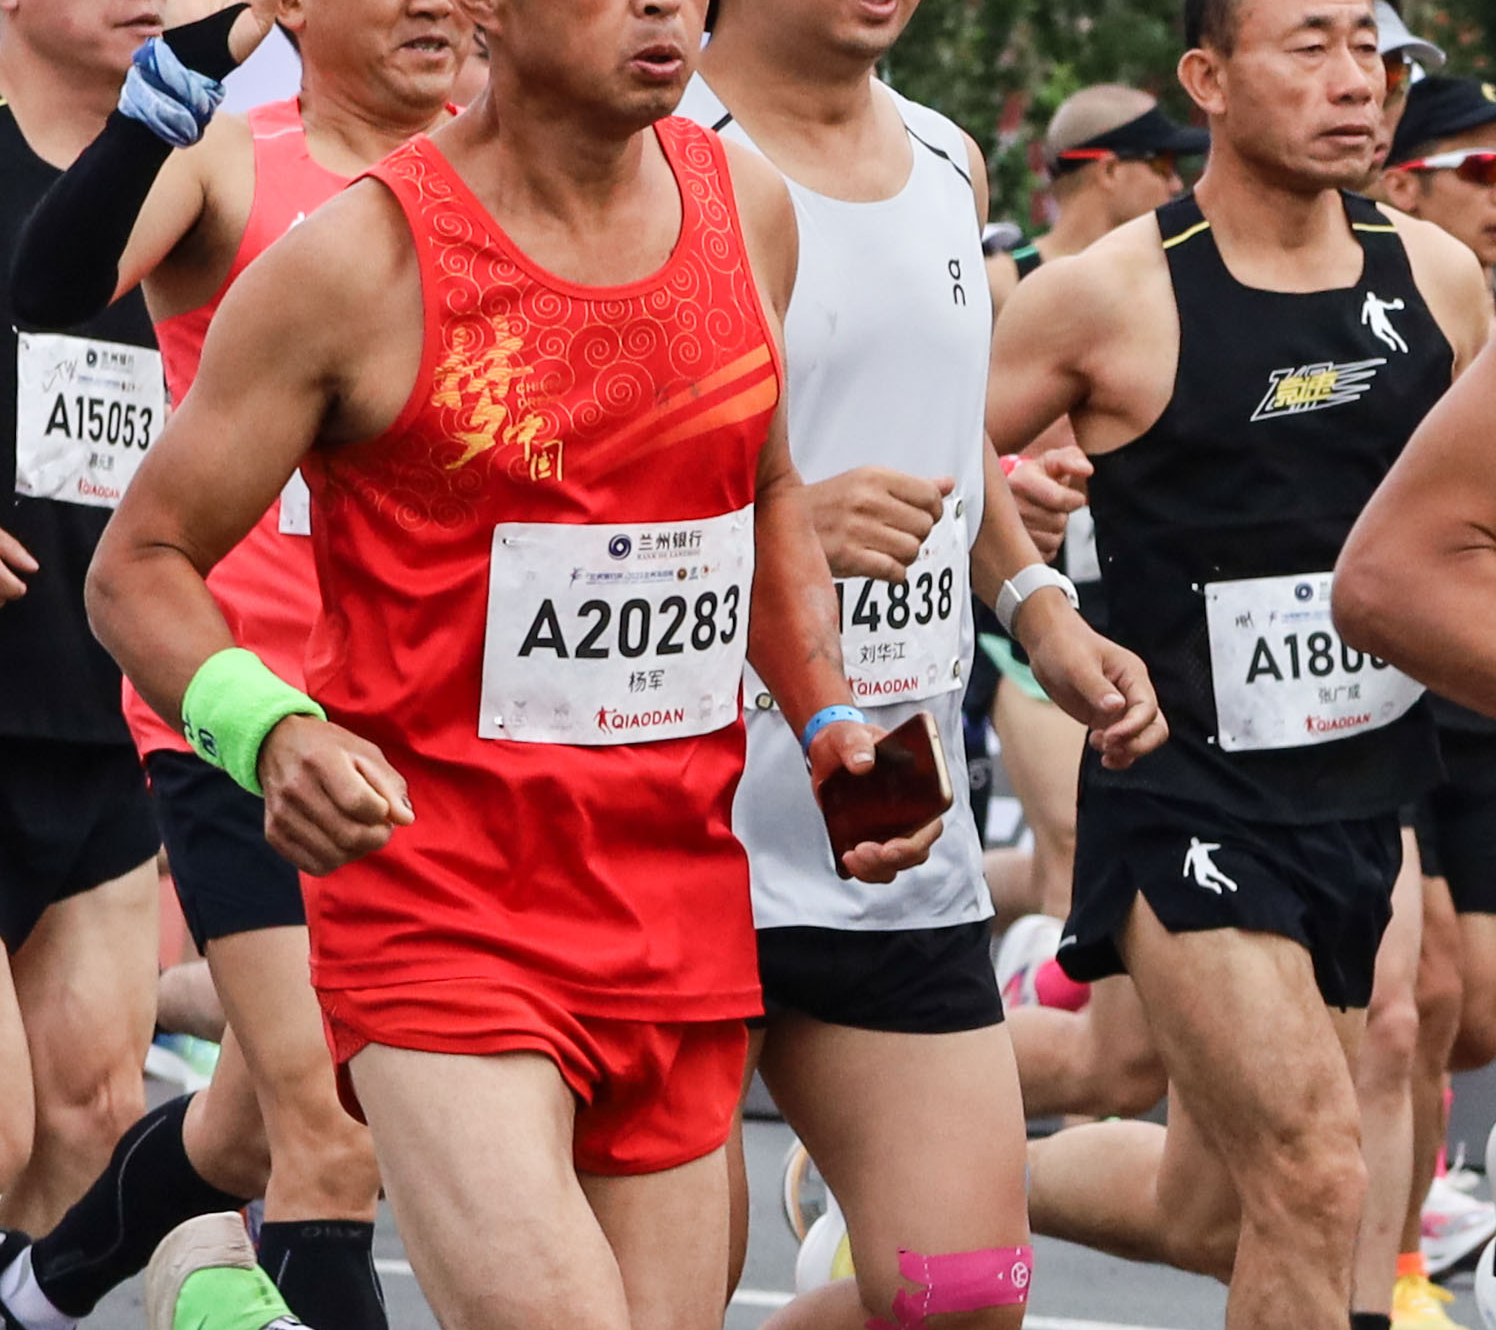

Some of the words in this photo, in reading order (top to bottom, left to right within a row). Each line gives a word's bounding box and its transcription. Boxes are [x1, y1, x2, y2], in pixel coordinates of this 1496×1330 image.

[44, 392, 153, 451] A15053
[638, 530, 703, 551] 兰州银行
[834, 566, 953, 635] 14838
[517, 584, 740, 659] A20283
[859, 641, 906, 663] 刘华江
[627, 669, 665, 693] 杨军
[857, 675, 919, 696] QIAODAN
[612, 707, 685, 730] QIAODAN
[1316, 713, 1372, 732] QIAODAN
